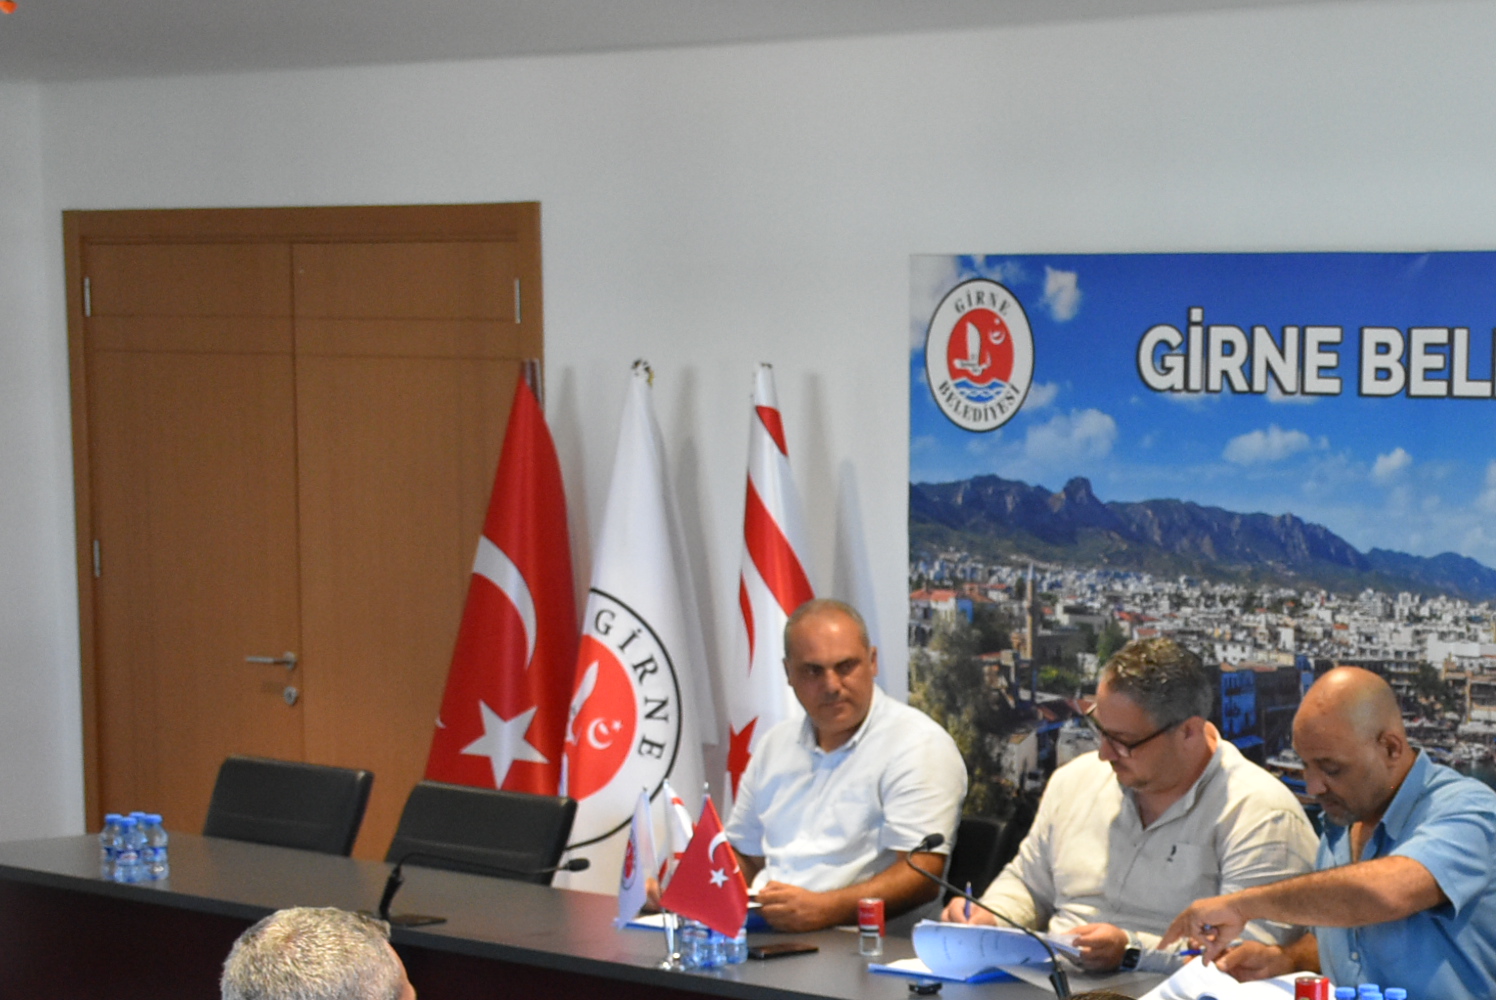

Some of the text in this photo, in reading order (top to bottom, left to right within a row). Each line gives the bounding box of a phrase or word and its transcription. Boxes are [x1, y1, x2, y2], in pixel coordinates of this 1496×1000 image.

[955, 289, 1011, 316] GİRNE
[1136, 306, 1343, 397] GİRNE
[938, 380, 1021, 423] BELEDİYESİ
[594, 608, 670, 760] GİRNE
